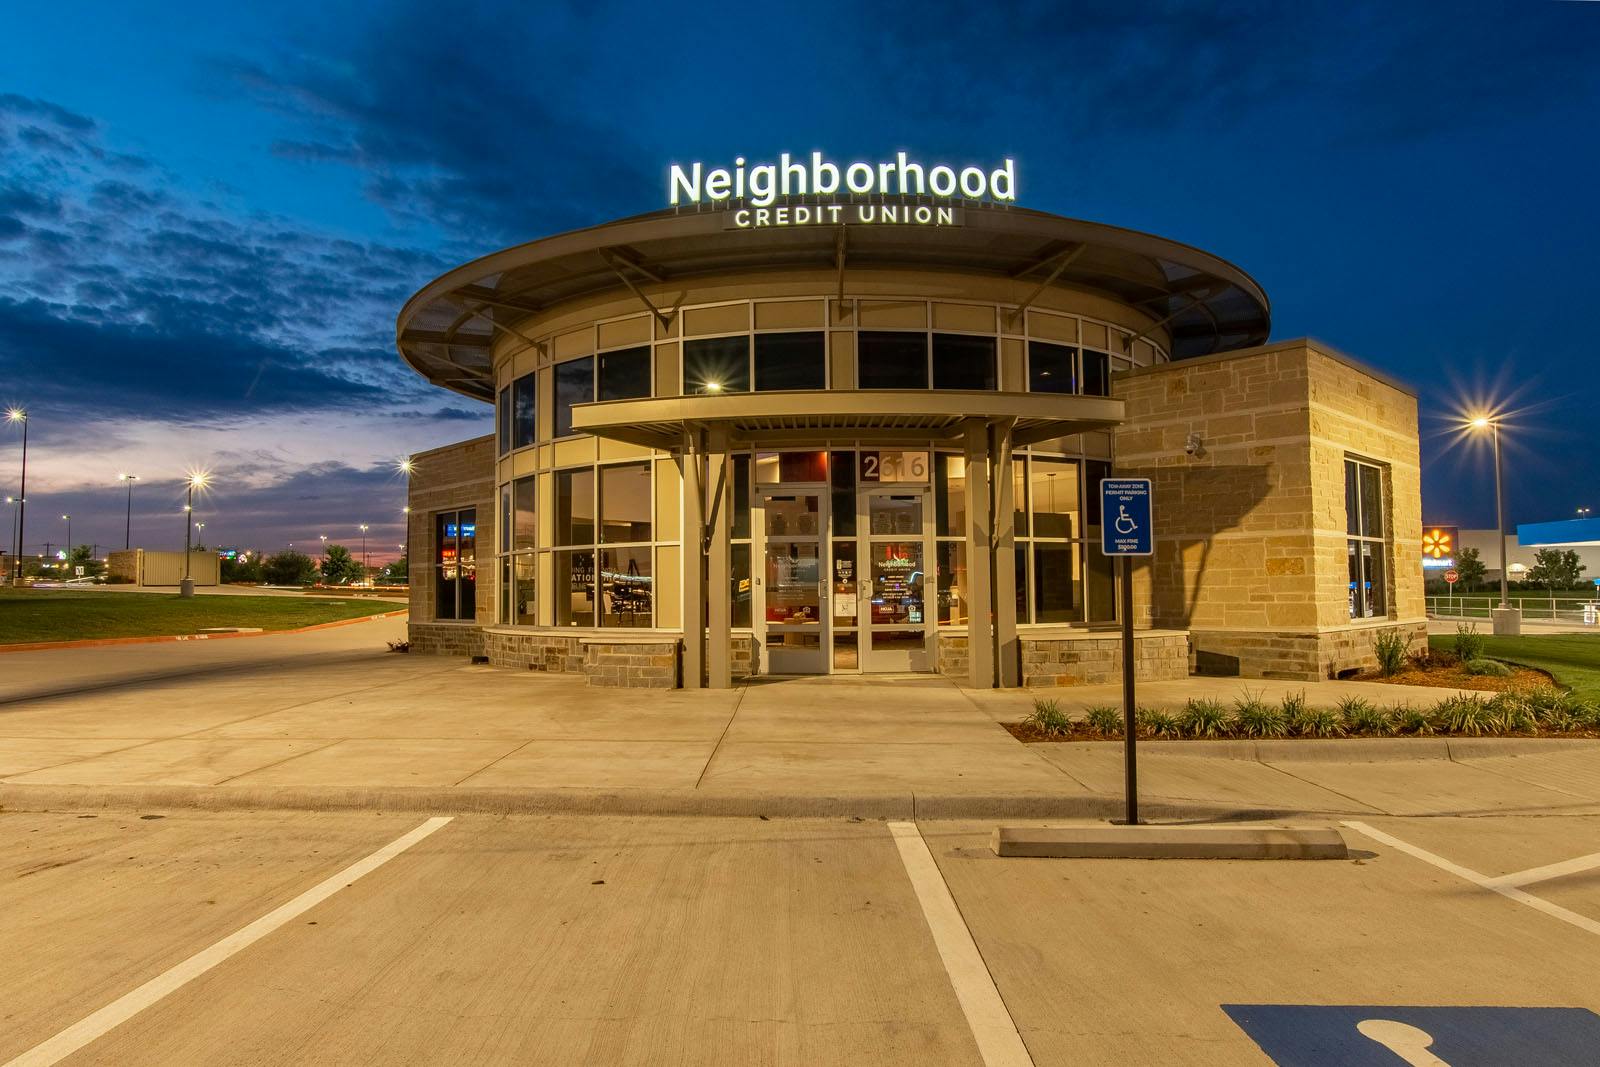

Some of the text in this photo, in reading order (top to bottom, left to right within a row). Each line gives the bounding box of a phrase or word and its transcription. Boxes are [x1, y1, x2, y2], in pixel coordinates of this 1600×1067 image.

[669, 151, 1016, 207] Neighborhood
[734, 206, 954, 228] CREDIT UNION
[864, 455, 925, 477] 2616
